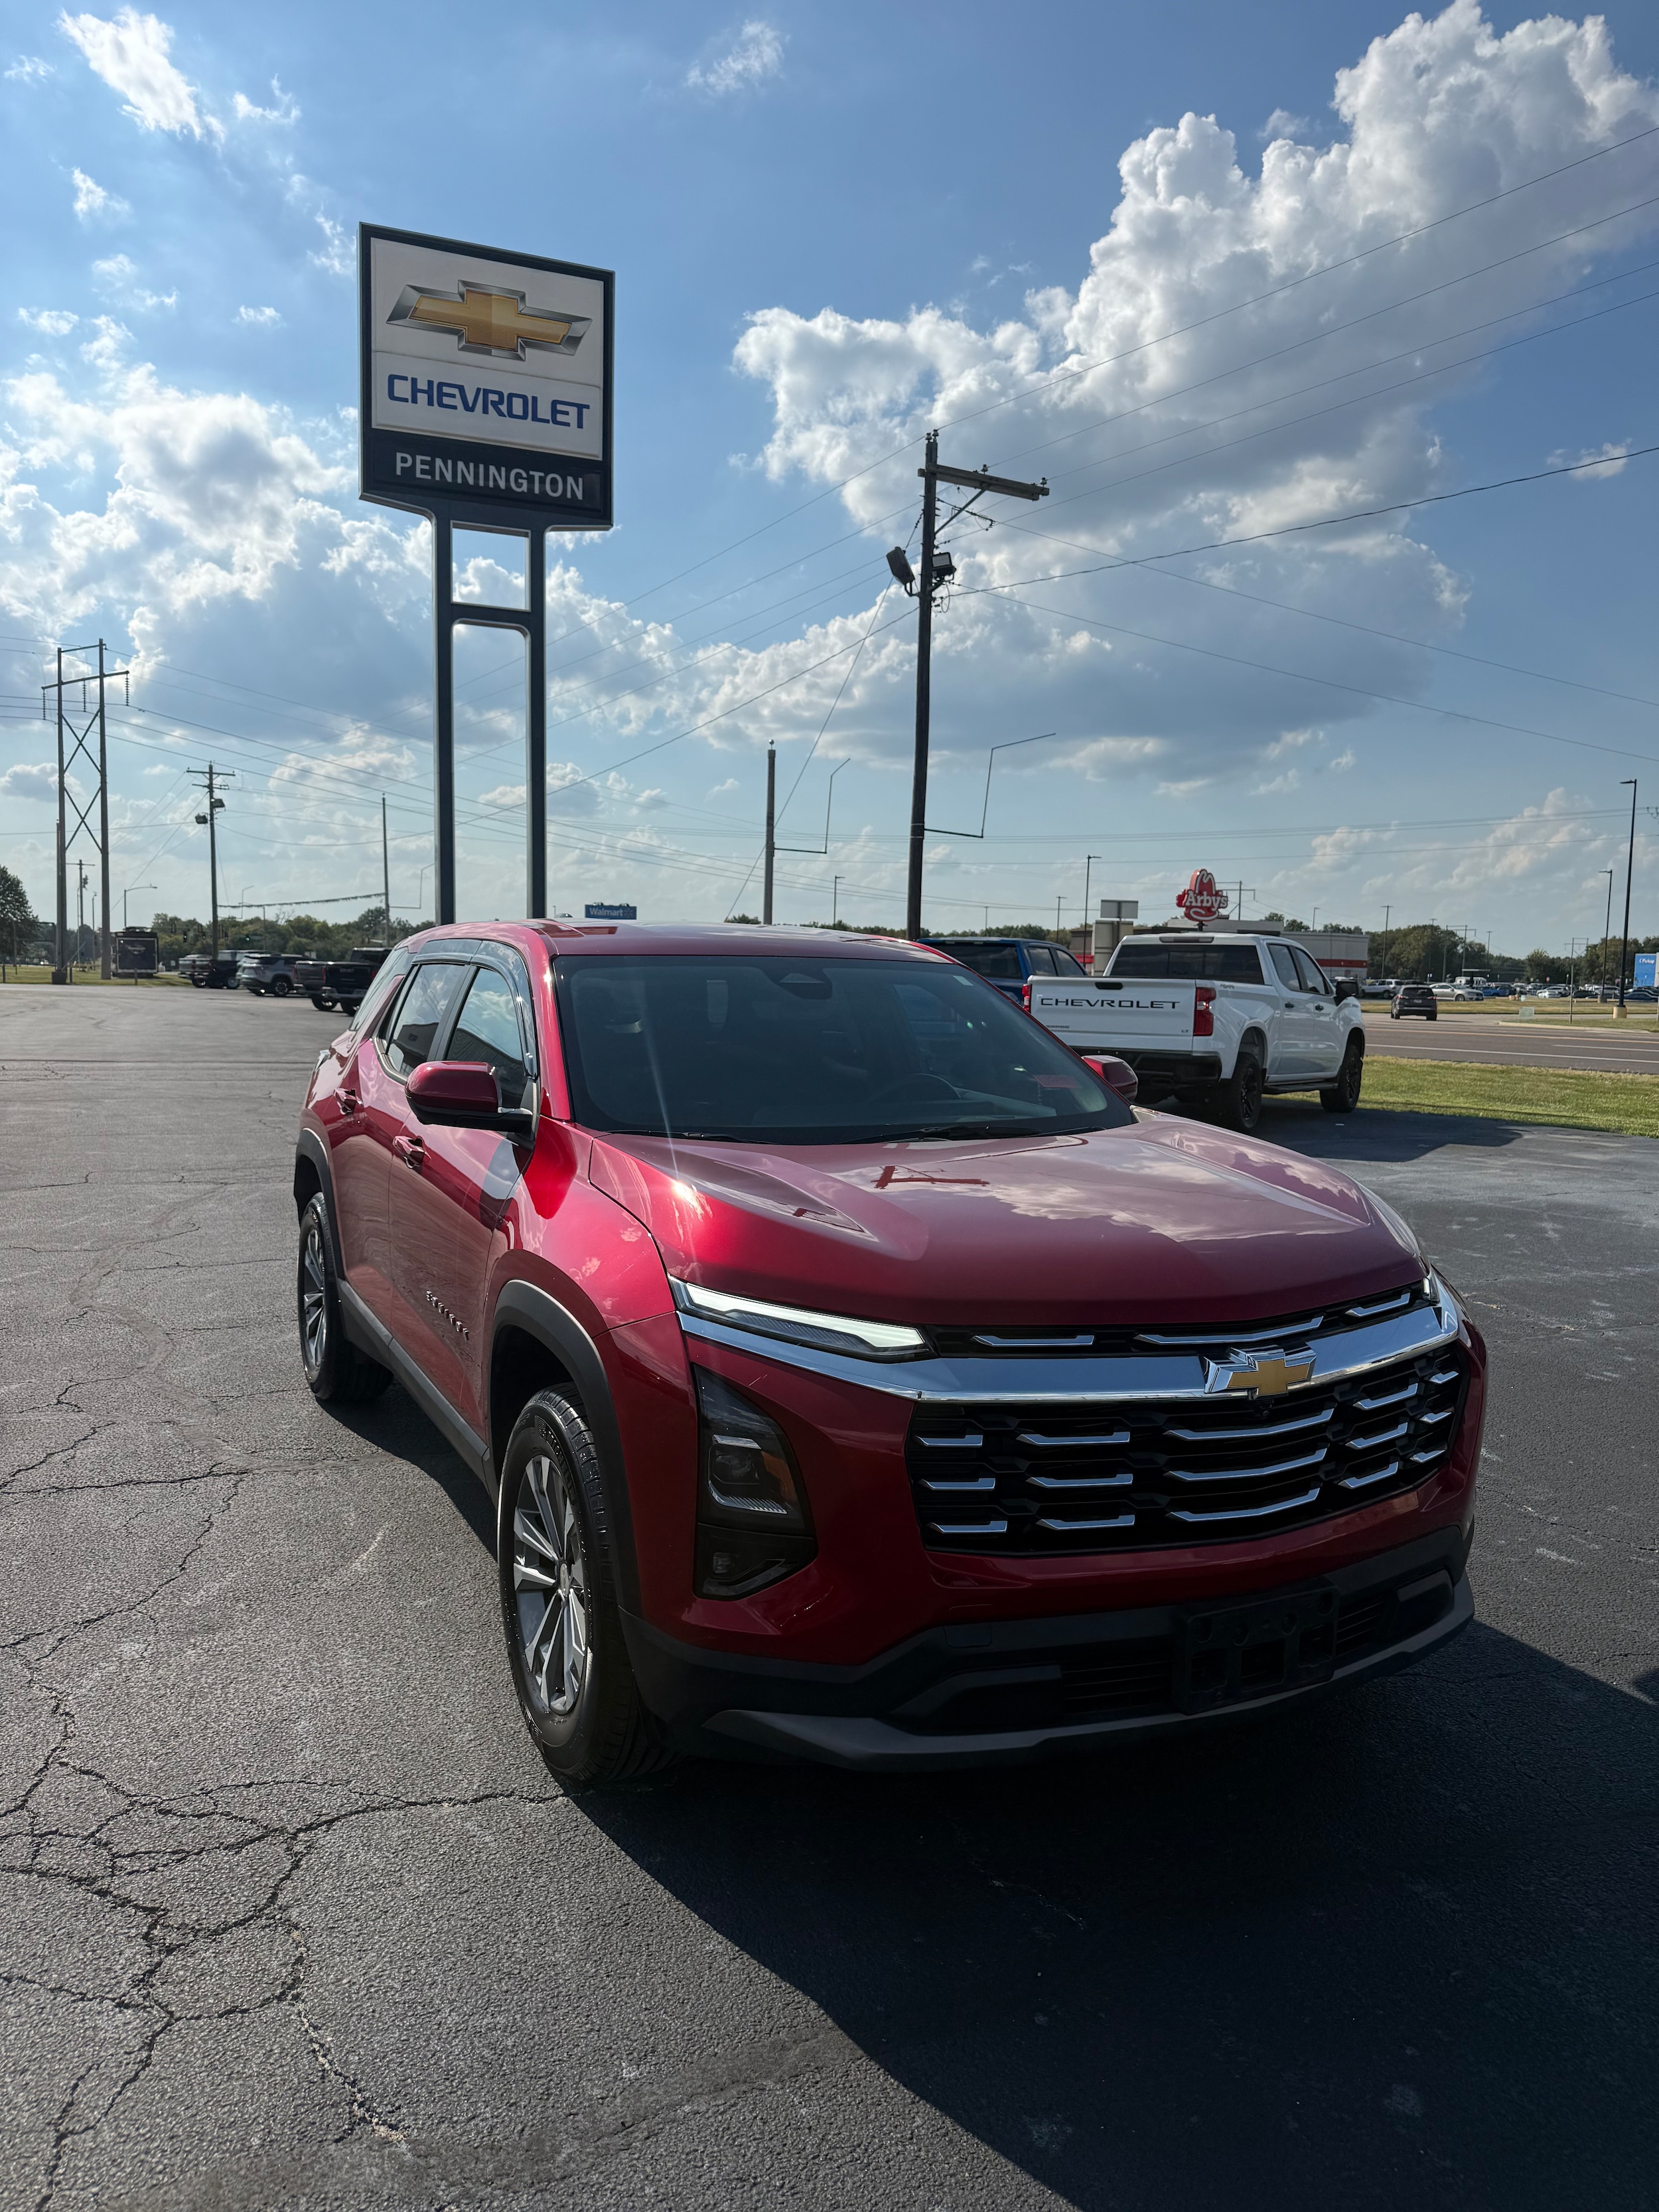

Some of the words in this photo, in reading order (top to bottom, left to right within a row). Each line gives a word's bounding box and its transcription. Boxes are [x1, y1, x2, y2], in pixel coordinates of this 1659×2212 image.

[388, 374, 590, 429] CHEVROLET
[396, 452, 583, 500] PENNINGTON
[589, 907, 623, 917] Walmart
[1041, 998, 1181, 1009] CHEVROLET
